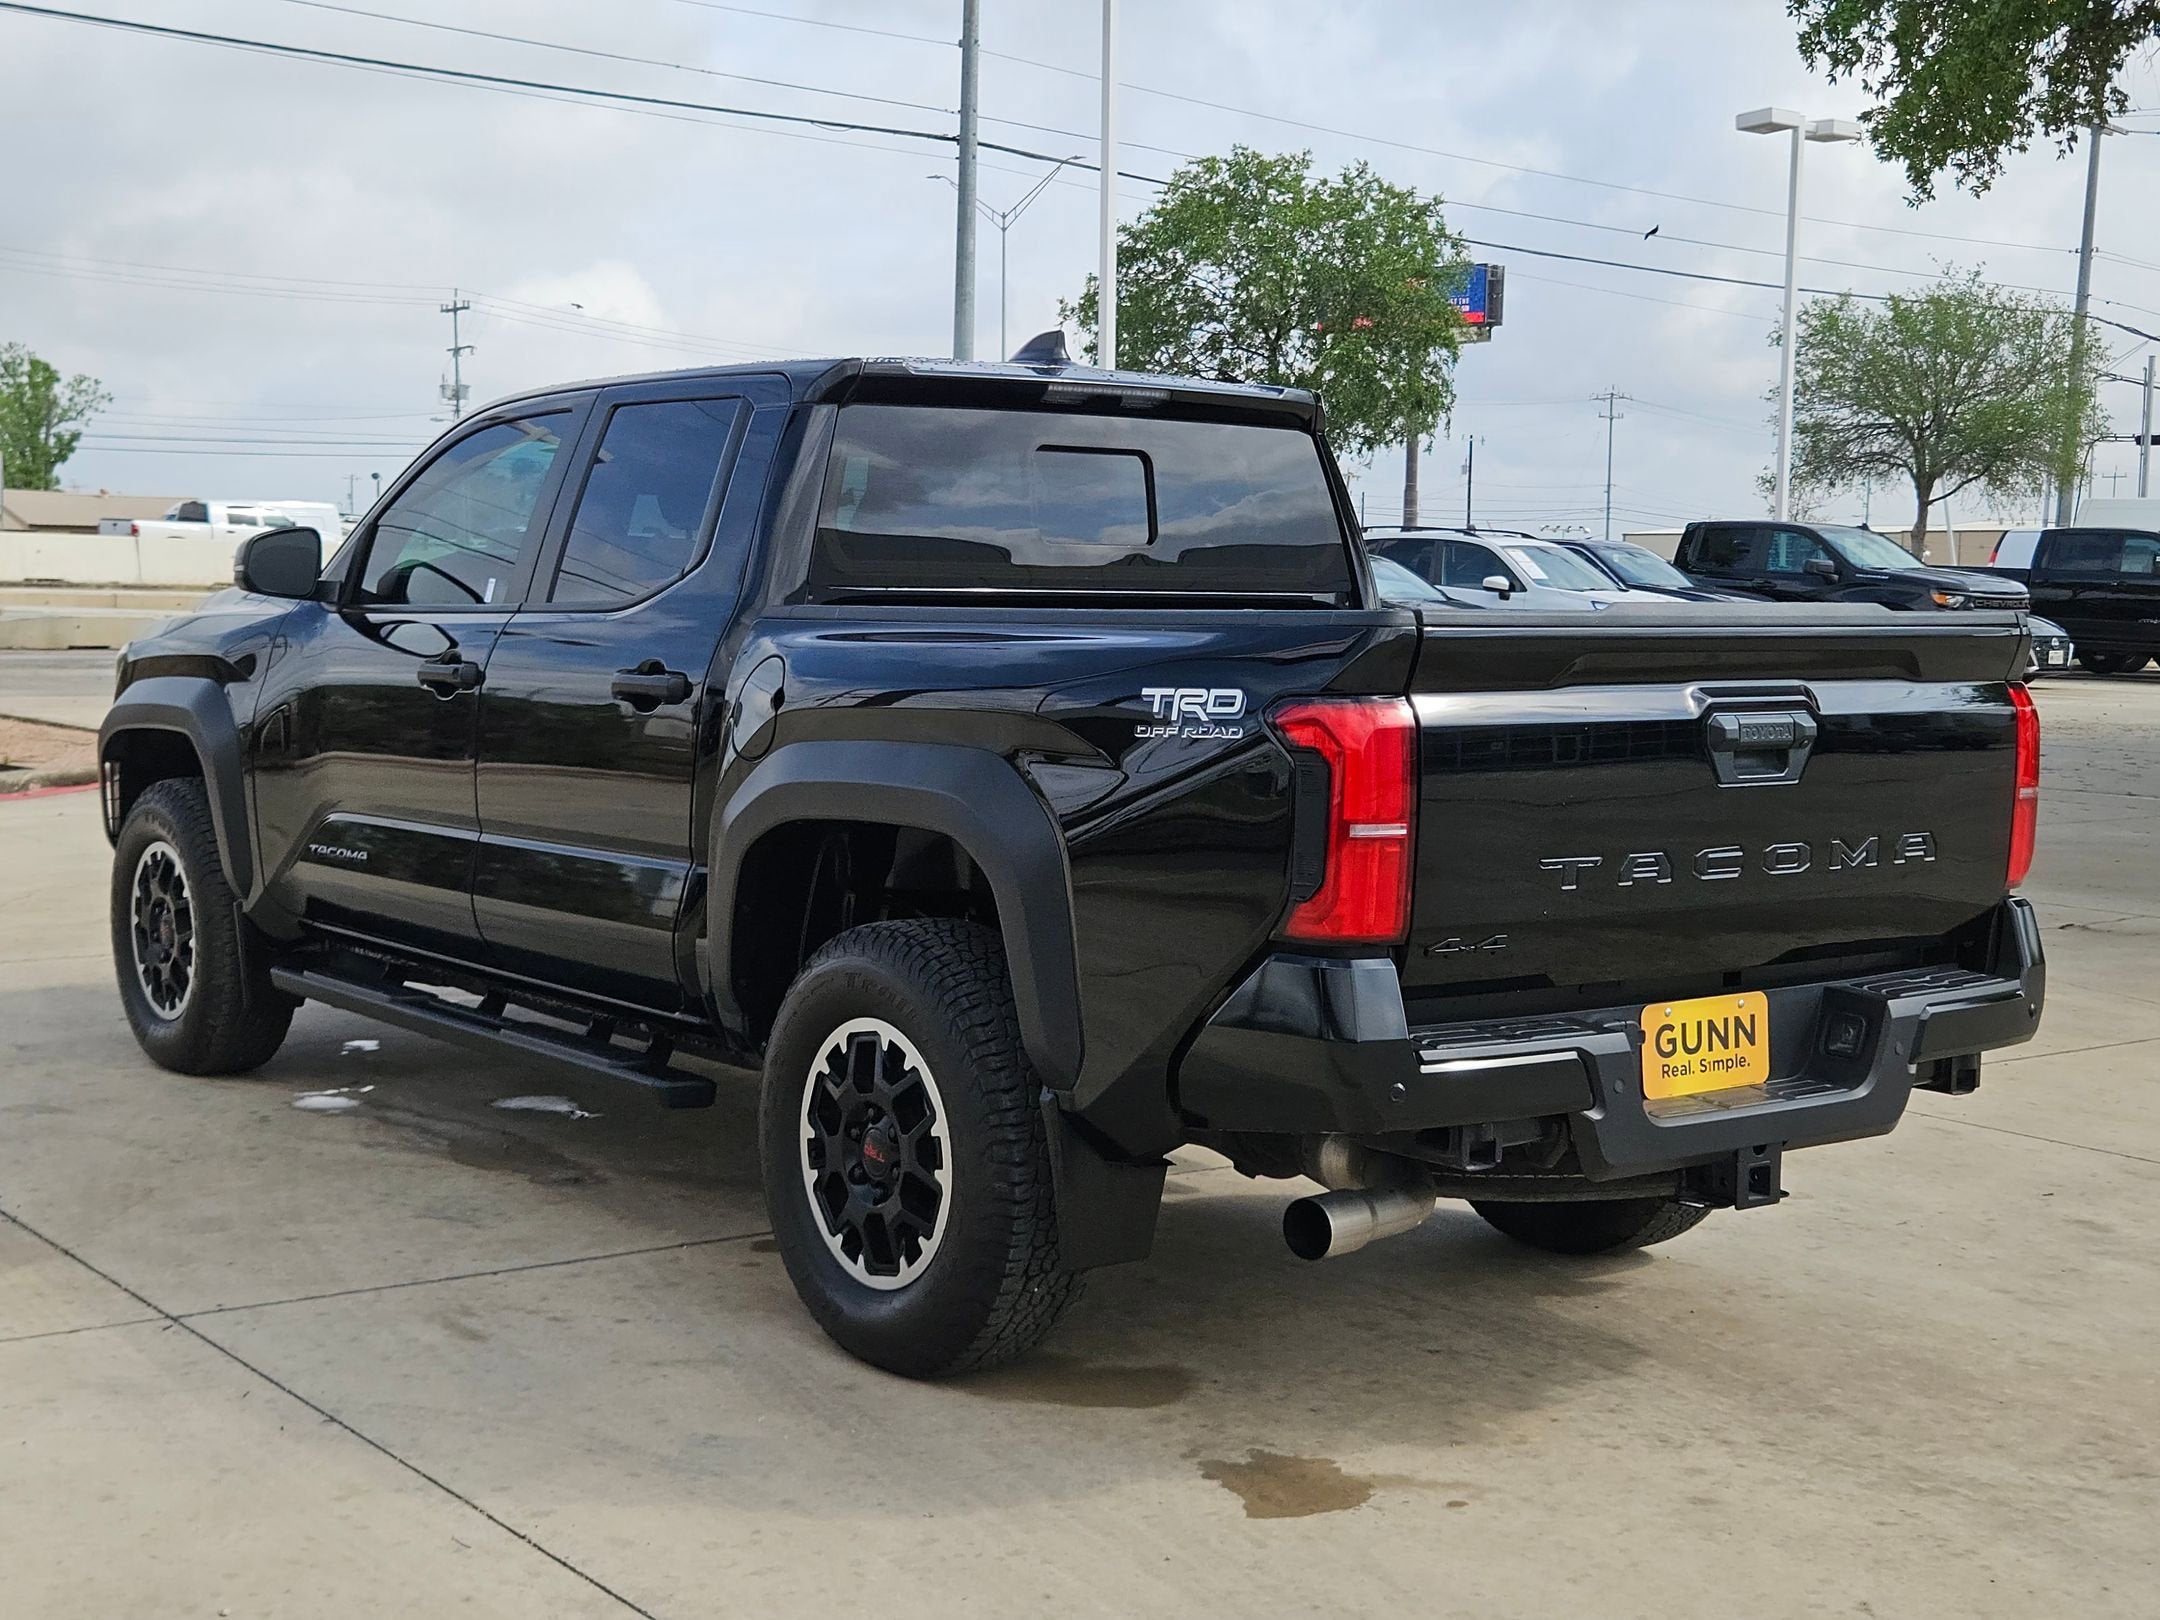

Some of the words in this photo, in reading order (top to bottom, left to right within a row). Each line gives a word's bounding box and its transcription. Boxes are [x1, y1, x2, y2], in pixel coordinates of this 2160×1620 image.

[1141, 687, 1247, 725] TRD
[1133, 725, 1179, 738] OFF
[1181, 726, 1243, 739] ROAD
[1743, 725, 1792, 740] TOYOTA
[308, 844, 368, 860] TACOMA
[1538, 832, 1937, 890] TACOMA
[1655, 1014, 1756, 1059] GUNN
[1662, 1060, 1695, 1079] Real.
